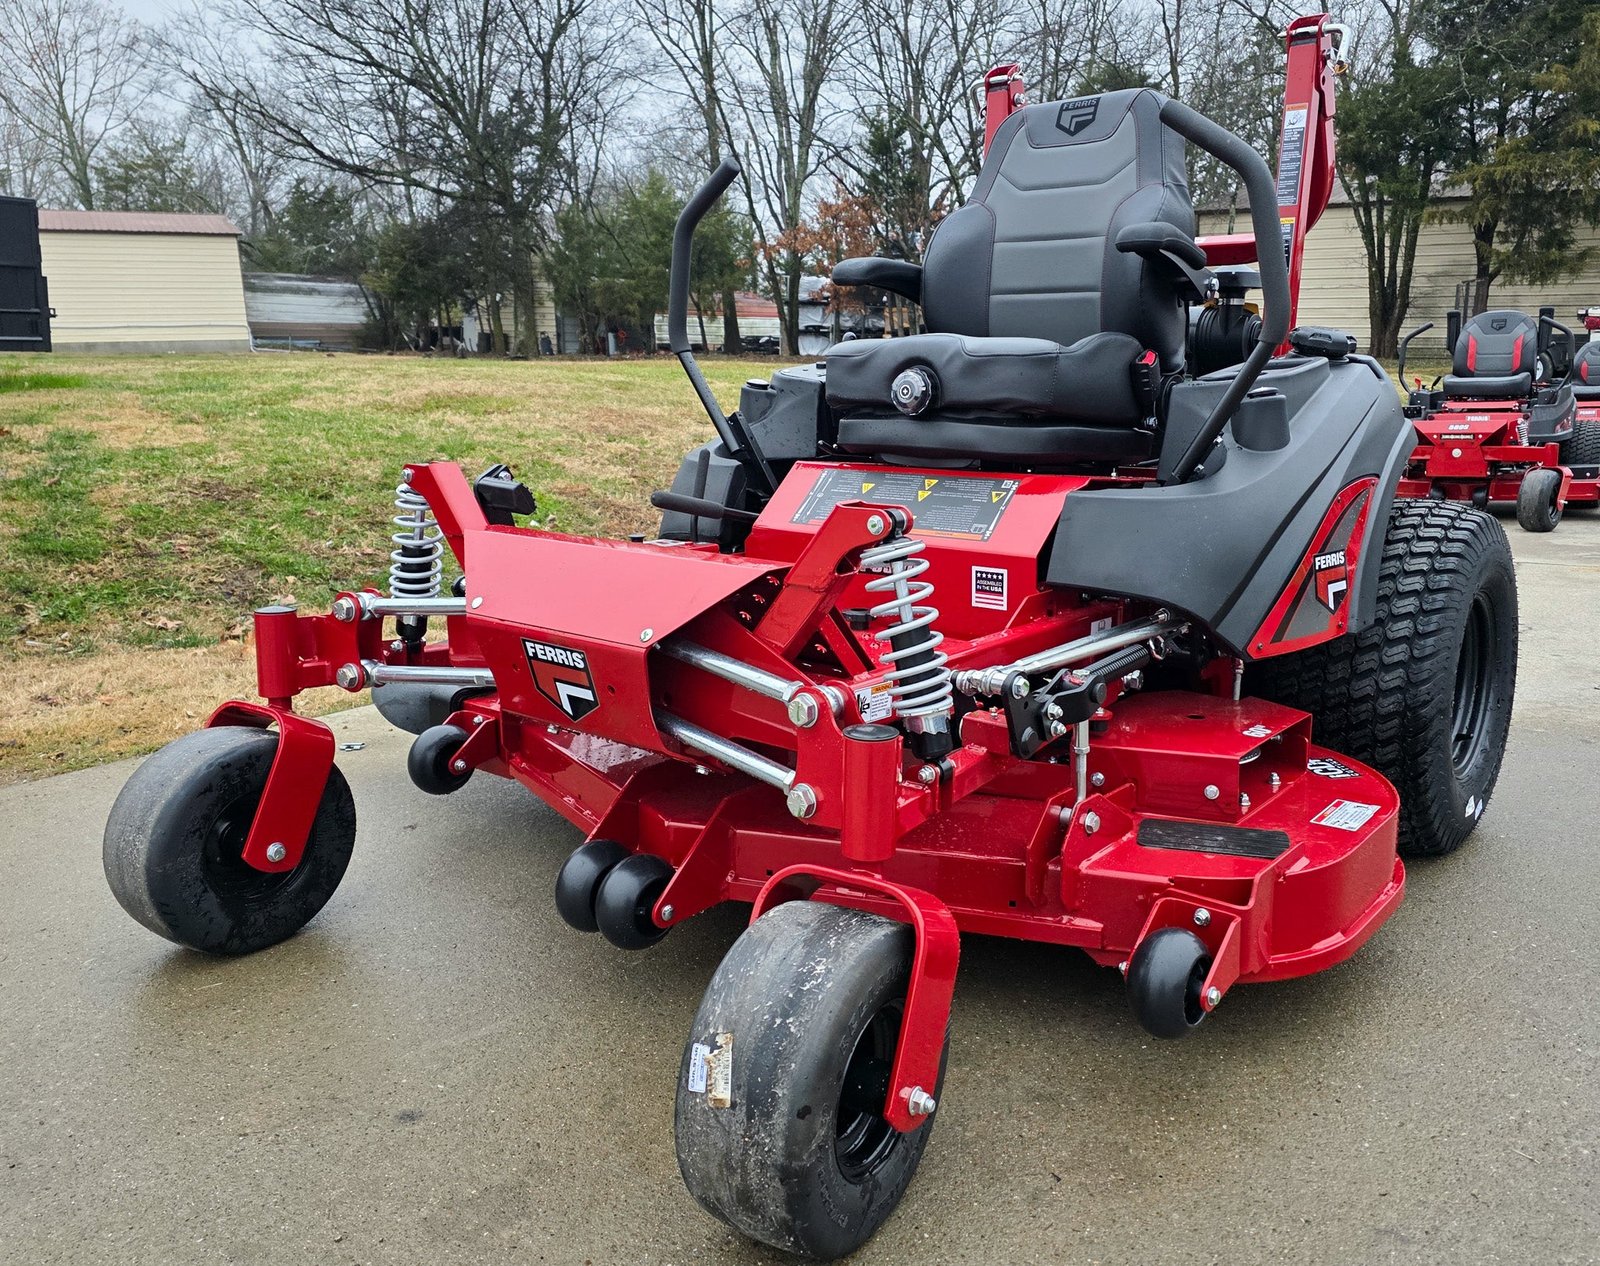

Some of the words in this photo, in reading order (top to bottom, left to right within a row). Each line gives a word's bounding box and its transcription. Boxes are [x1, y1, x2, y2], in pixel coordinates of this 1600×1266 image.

[1062, 98, 1098, 110] FERRIS
[1315, 552, 1345, 570] FERRIS
[976, 579, 1003, 587] ASSEMBLED
[525, 641, 585, 669] FERRIS
